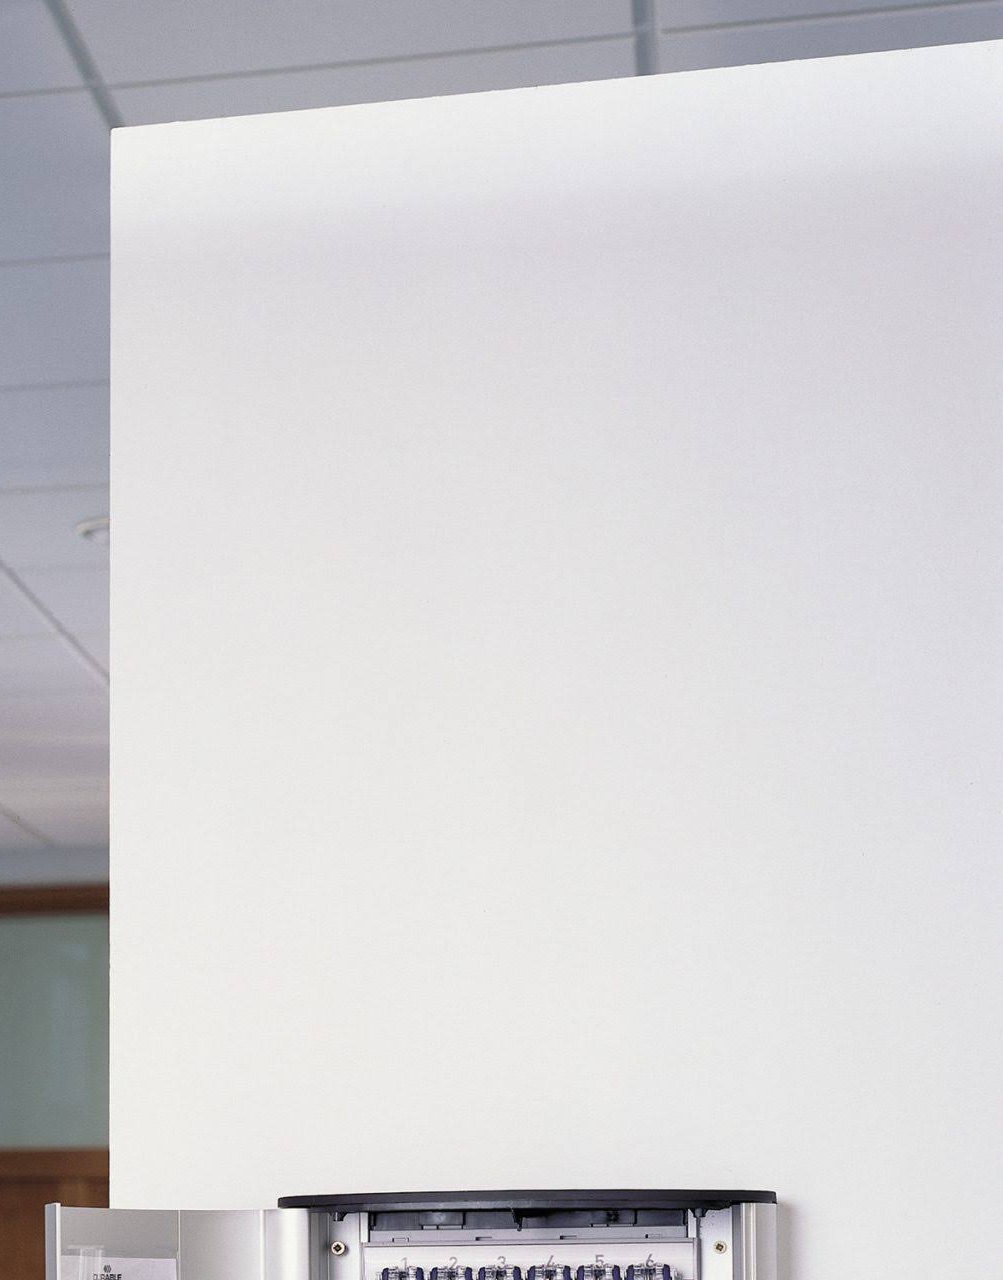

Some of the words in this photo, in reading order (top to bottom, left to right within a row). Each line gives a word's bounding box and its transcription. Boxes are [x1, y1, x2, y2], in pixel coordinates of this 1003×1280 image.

[401, 1257, 407, 1269] 1
[449, 1257, 457, 1269] 2
[497, 1256, 506, 1269] 3
[595, 1254, 604, 1269] 5
[645, 1253, 654, 1268] 6
